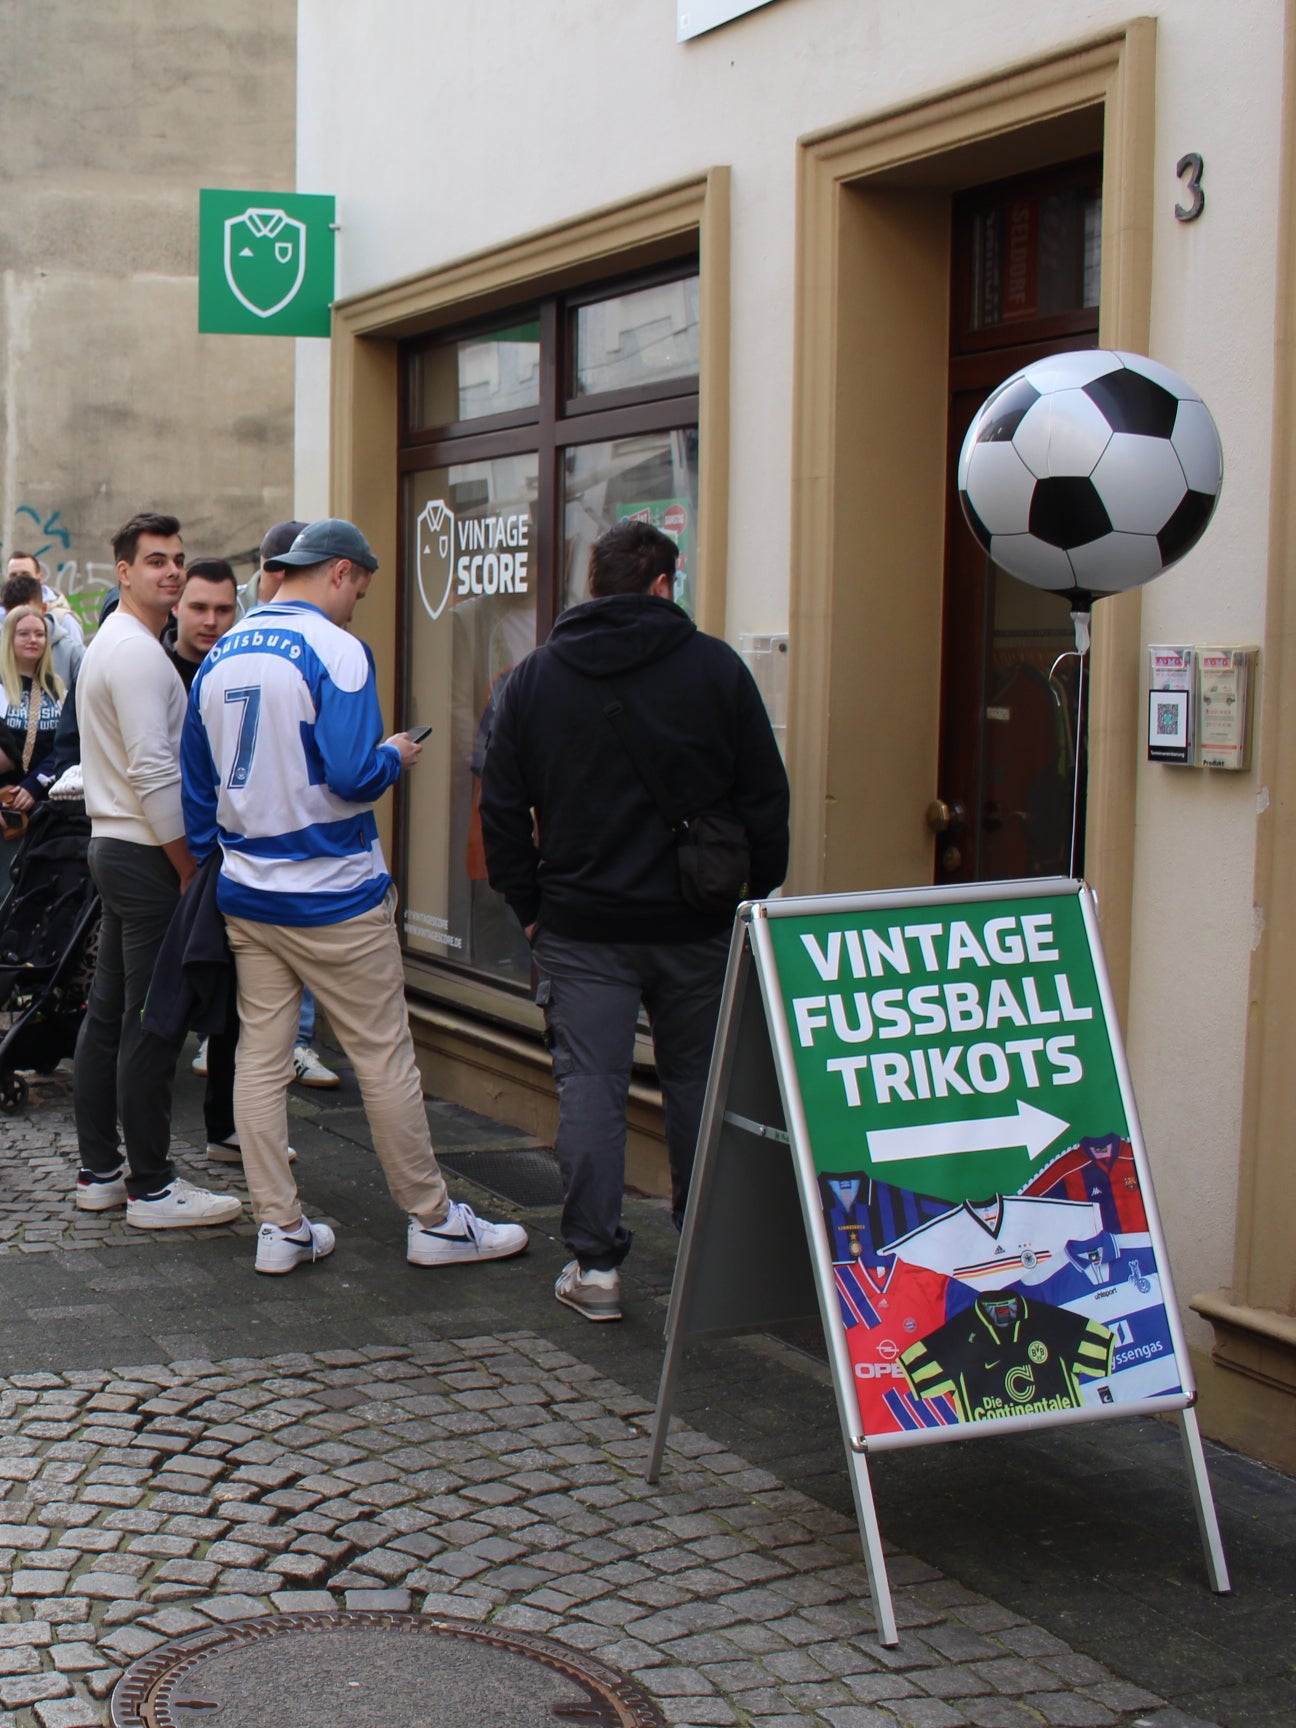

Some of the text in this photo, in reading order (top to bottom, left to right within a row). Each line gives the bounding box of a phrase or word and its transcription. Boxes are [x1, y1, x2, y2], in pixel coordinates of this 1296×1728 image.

[1175, 153, 1205, 222] 3
[457, 514, 529, 551] VINTAGE
[457, 552, 528, 595] SCORE
[210, 631, 302, 663] Duisburg
[224, 685, 261, 789] 7
[800, 913, 1059, 981] VINTAGE
[792, 973, 1093, 1047] FUSSBALL
[826, 1035, 1083, 1107] TRIKOTS
[1094, 1287, 1118, 1300] uhlsport
[855, 1363, 905, 1379] OPE
[1111, 1340, 1163, 1370] yssengas
[974, 1393, 1072, 1422] Continentale
[982, 1396, 1003, 1409] Die
